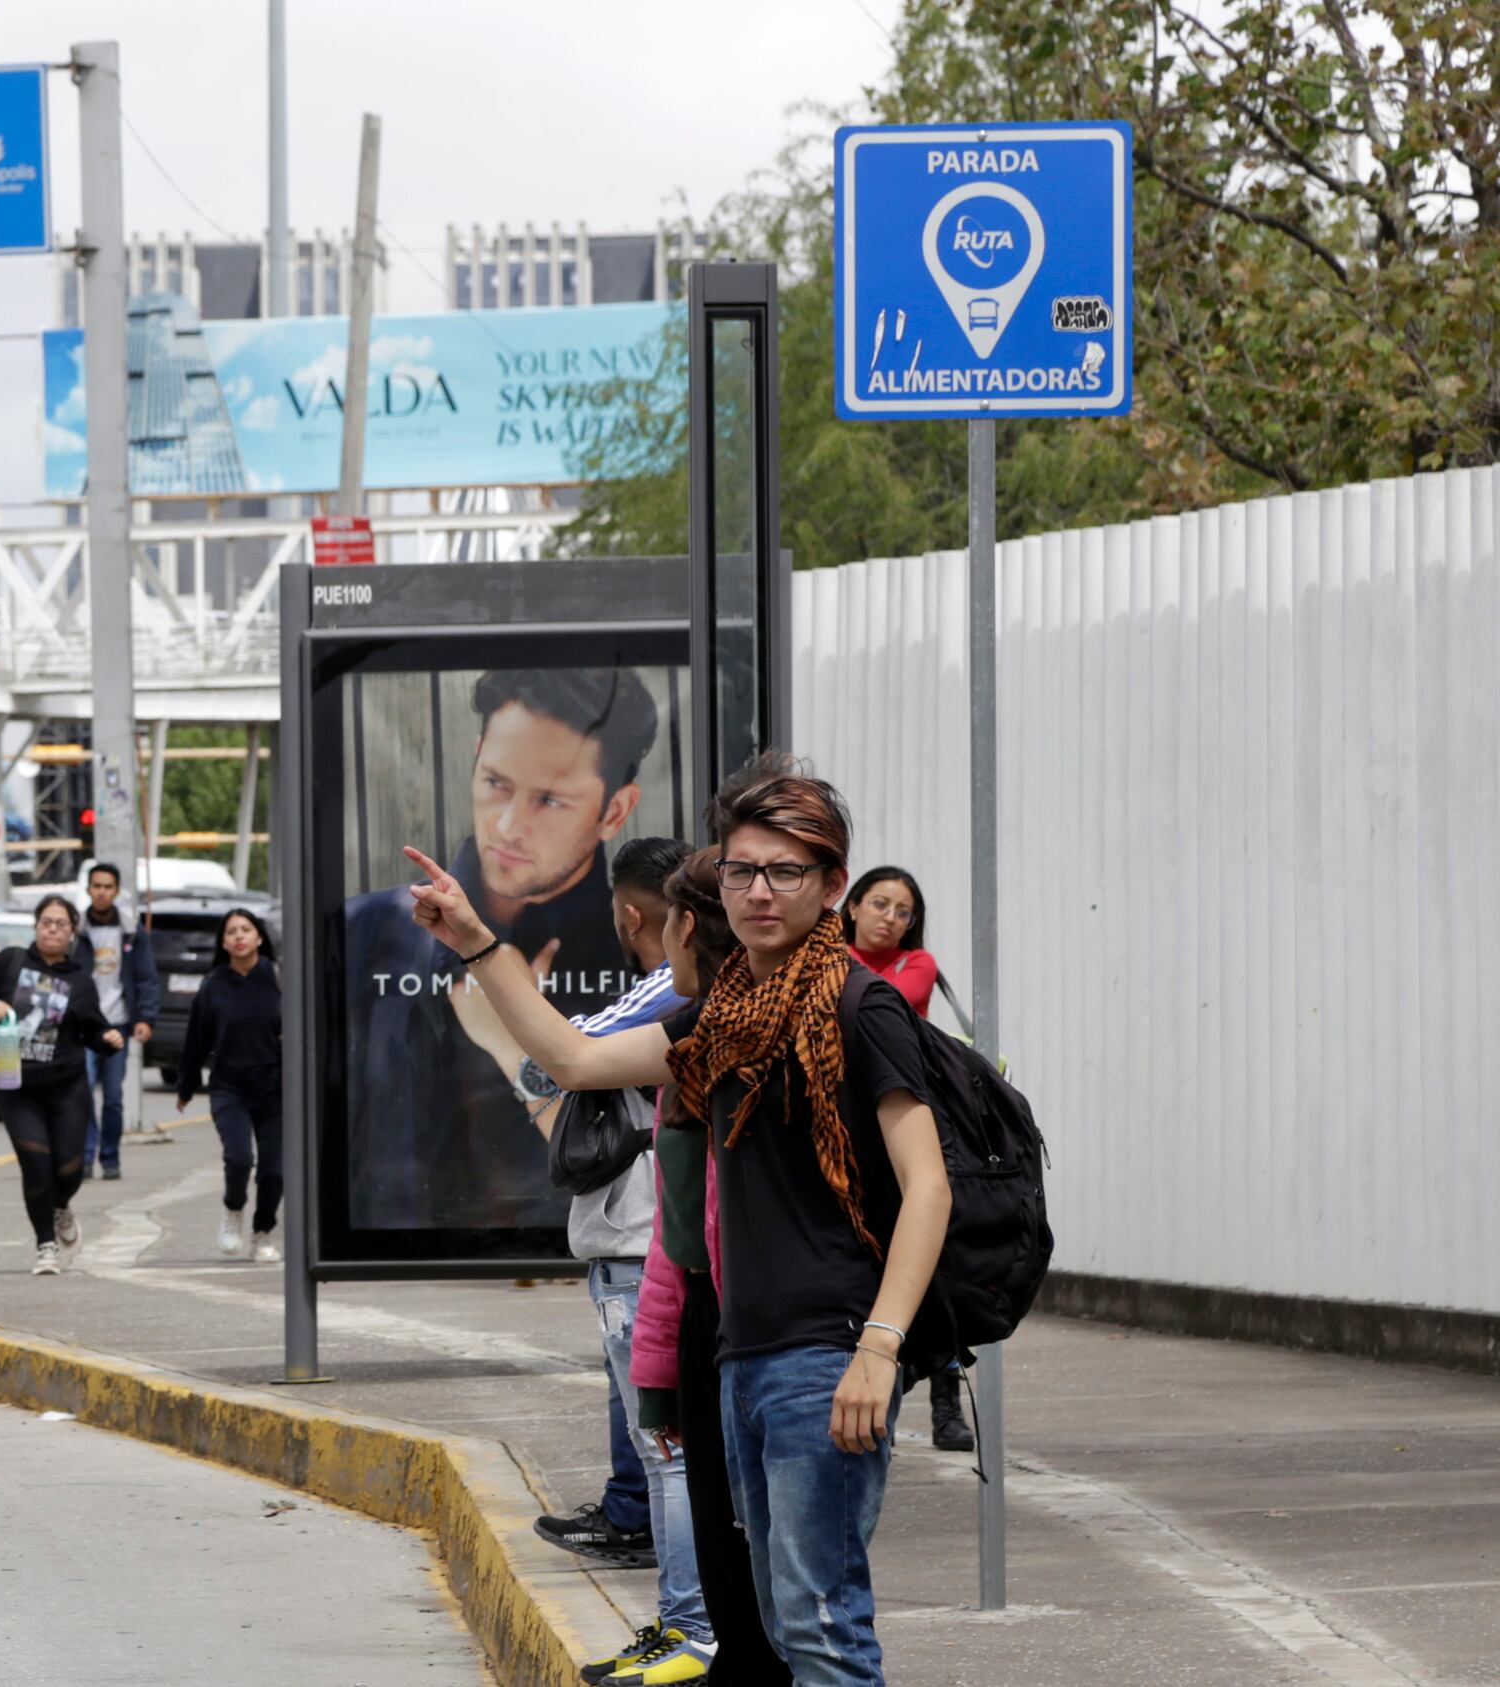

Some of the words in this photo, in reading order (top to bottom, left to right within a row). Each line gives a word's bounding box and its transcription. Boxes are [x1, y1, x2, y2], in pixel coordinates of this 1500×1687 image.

[927, 149, 1040, 174] PARADA
[953, 231, 1014, 251] RUTA
[496, 350, 581, 377] YOUR
[867, 366, 1102, 393] ALIMENTADORAS
[284, 374, 458, 419] VADA
[498, 420, 521, 446] IS
[313, 584, 373, 606] PUE1100
